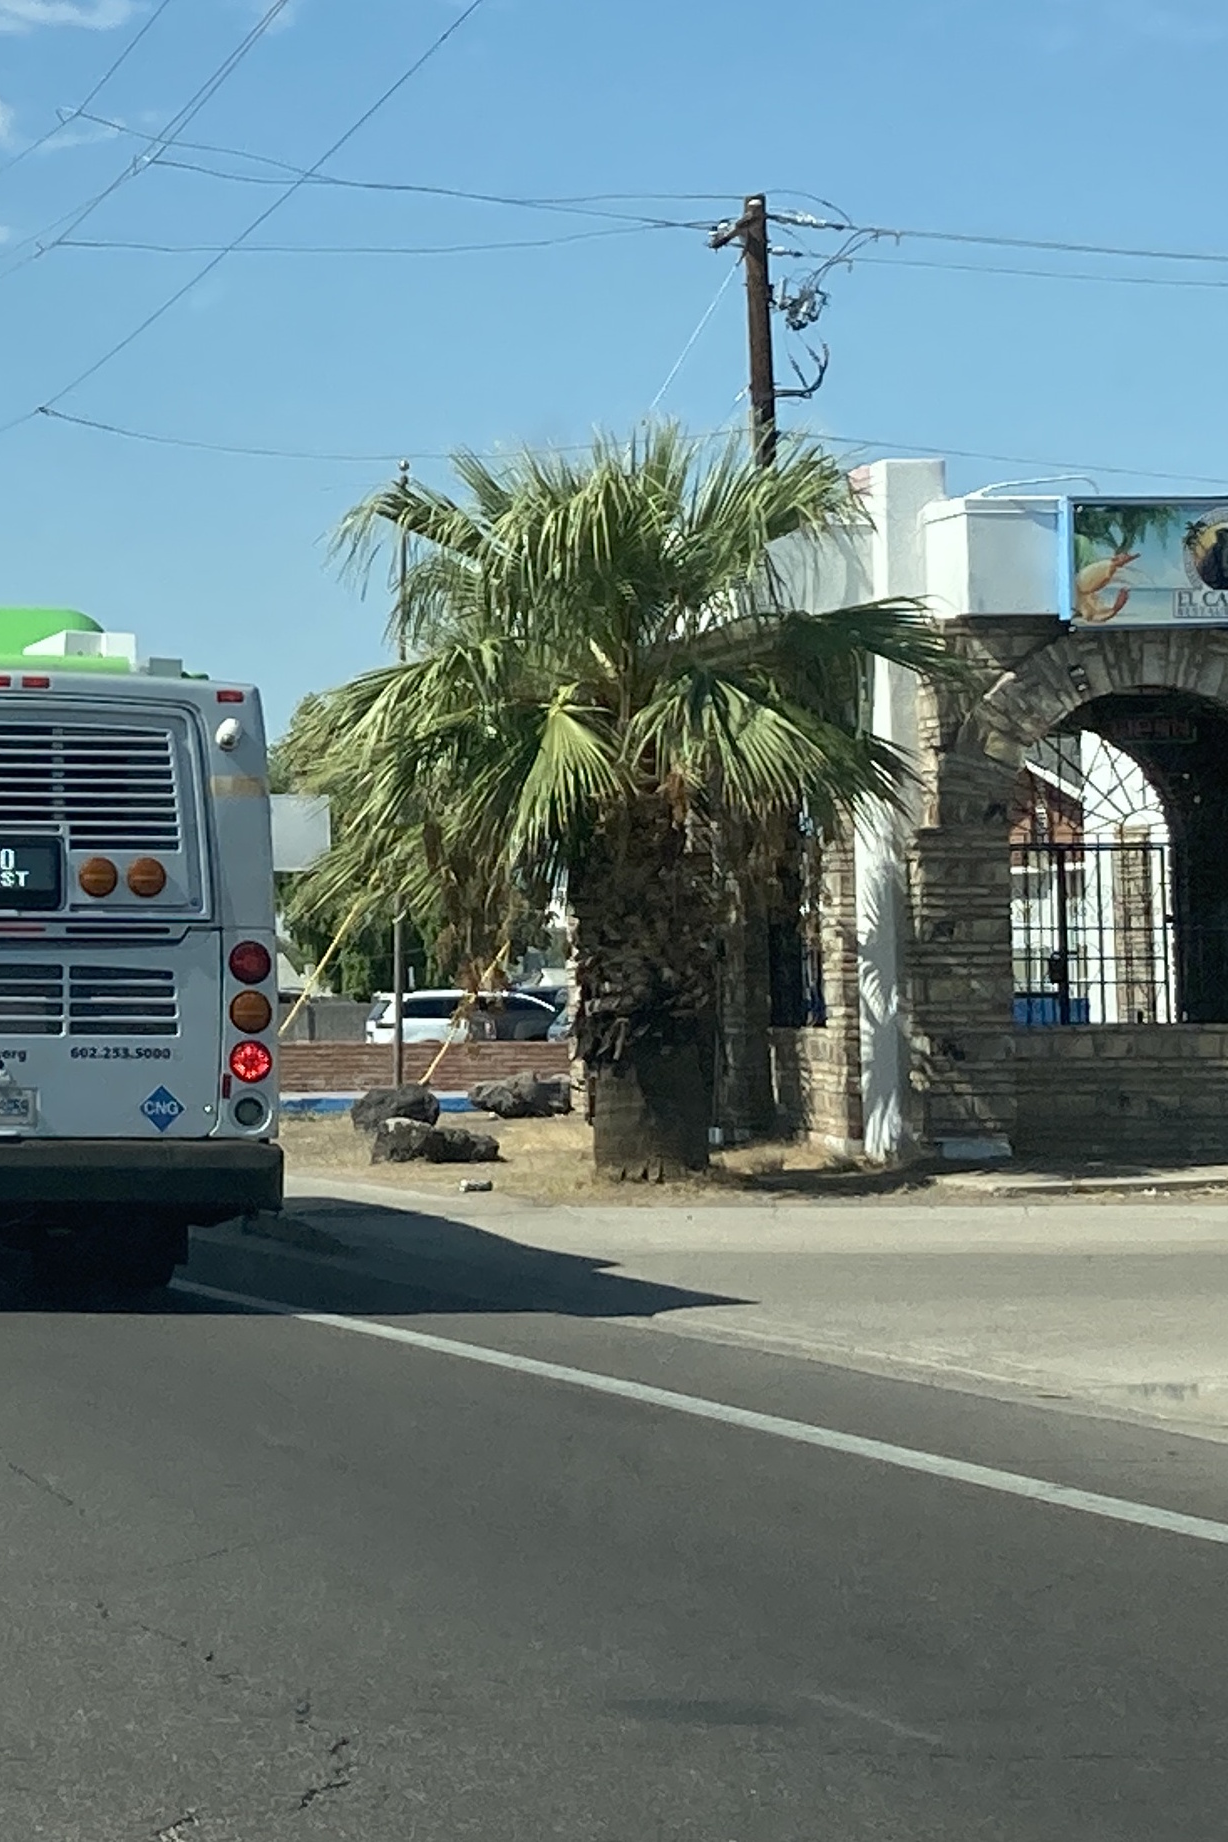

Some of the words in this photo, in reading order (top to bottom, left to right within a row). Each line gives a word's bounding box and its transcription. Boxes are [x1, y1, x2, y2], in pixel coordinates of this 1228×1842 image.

[1177, 590, 1198, 607] EL
[70, 1047, 171, 1060] 602.253.5000
[143, 1100, 179, 1115] CNG
